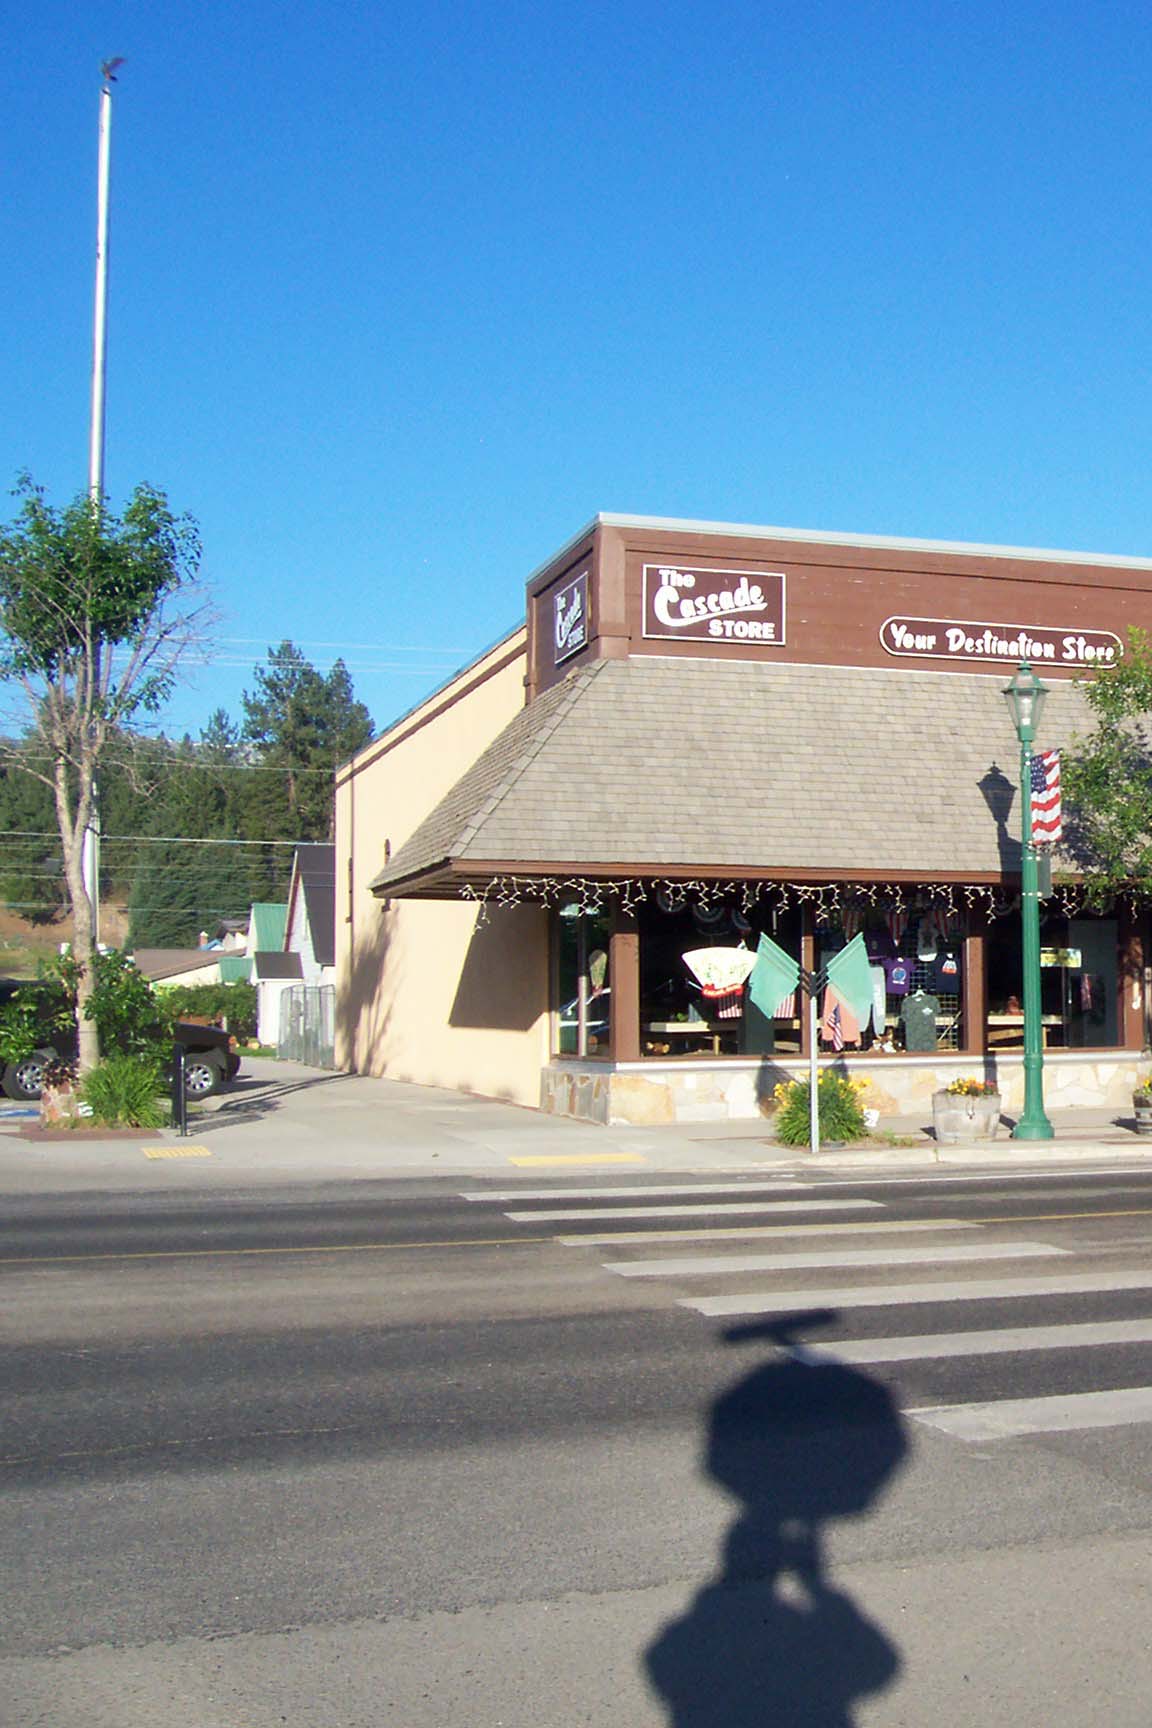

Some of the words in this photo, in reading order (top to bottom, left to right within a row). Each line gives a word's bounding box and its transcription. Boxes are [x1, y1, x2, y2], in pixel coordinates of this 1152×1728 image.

[658, 568, 696, 588] The
[654, 577, 768, 627] Cascade
[708, 618, 775, 640] STORE
[890, 622, 937, 651] Your
[945, 627, 1056, 659] Destination
[1062, 636, 1115, 661] Store
